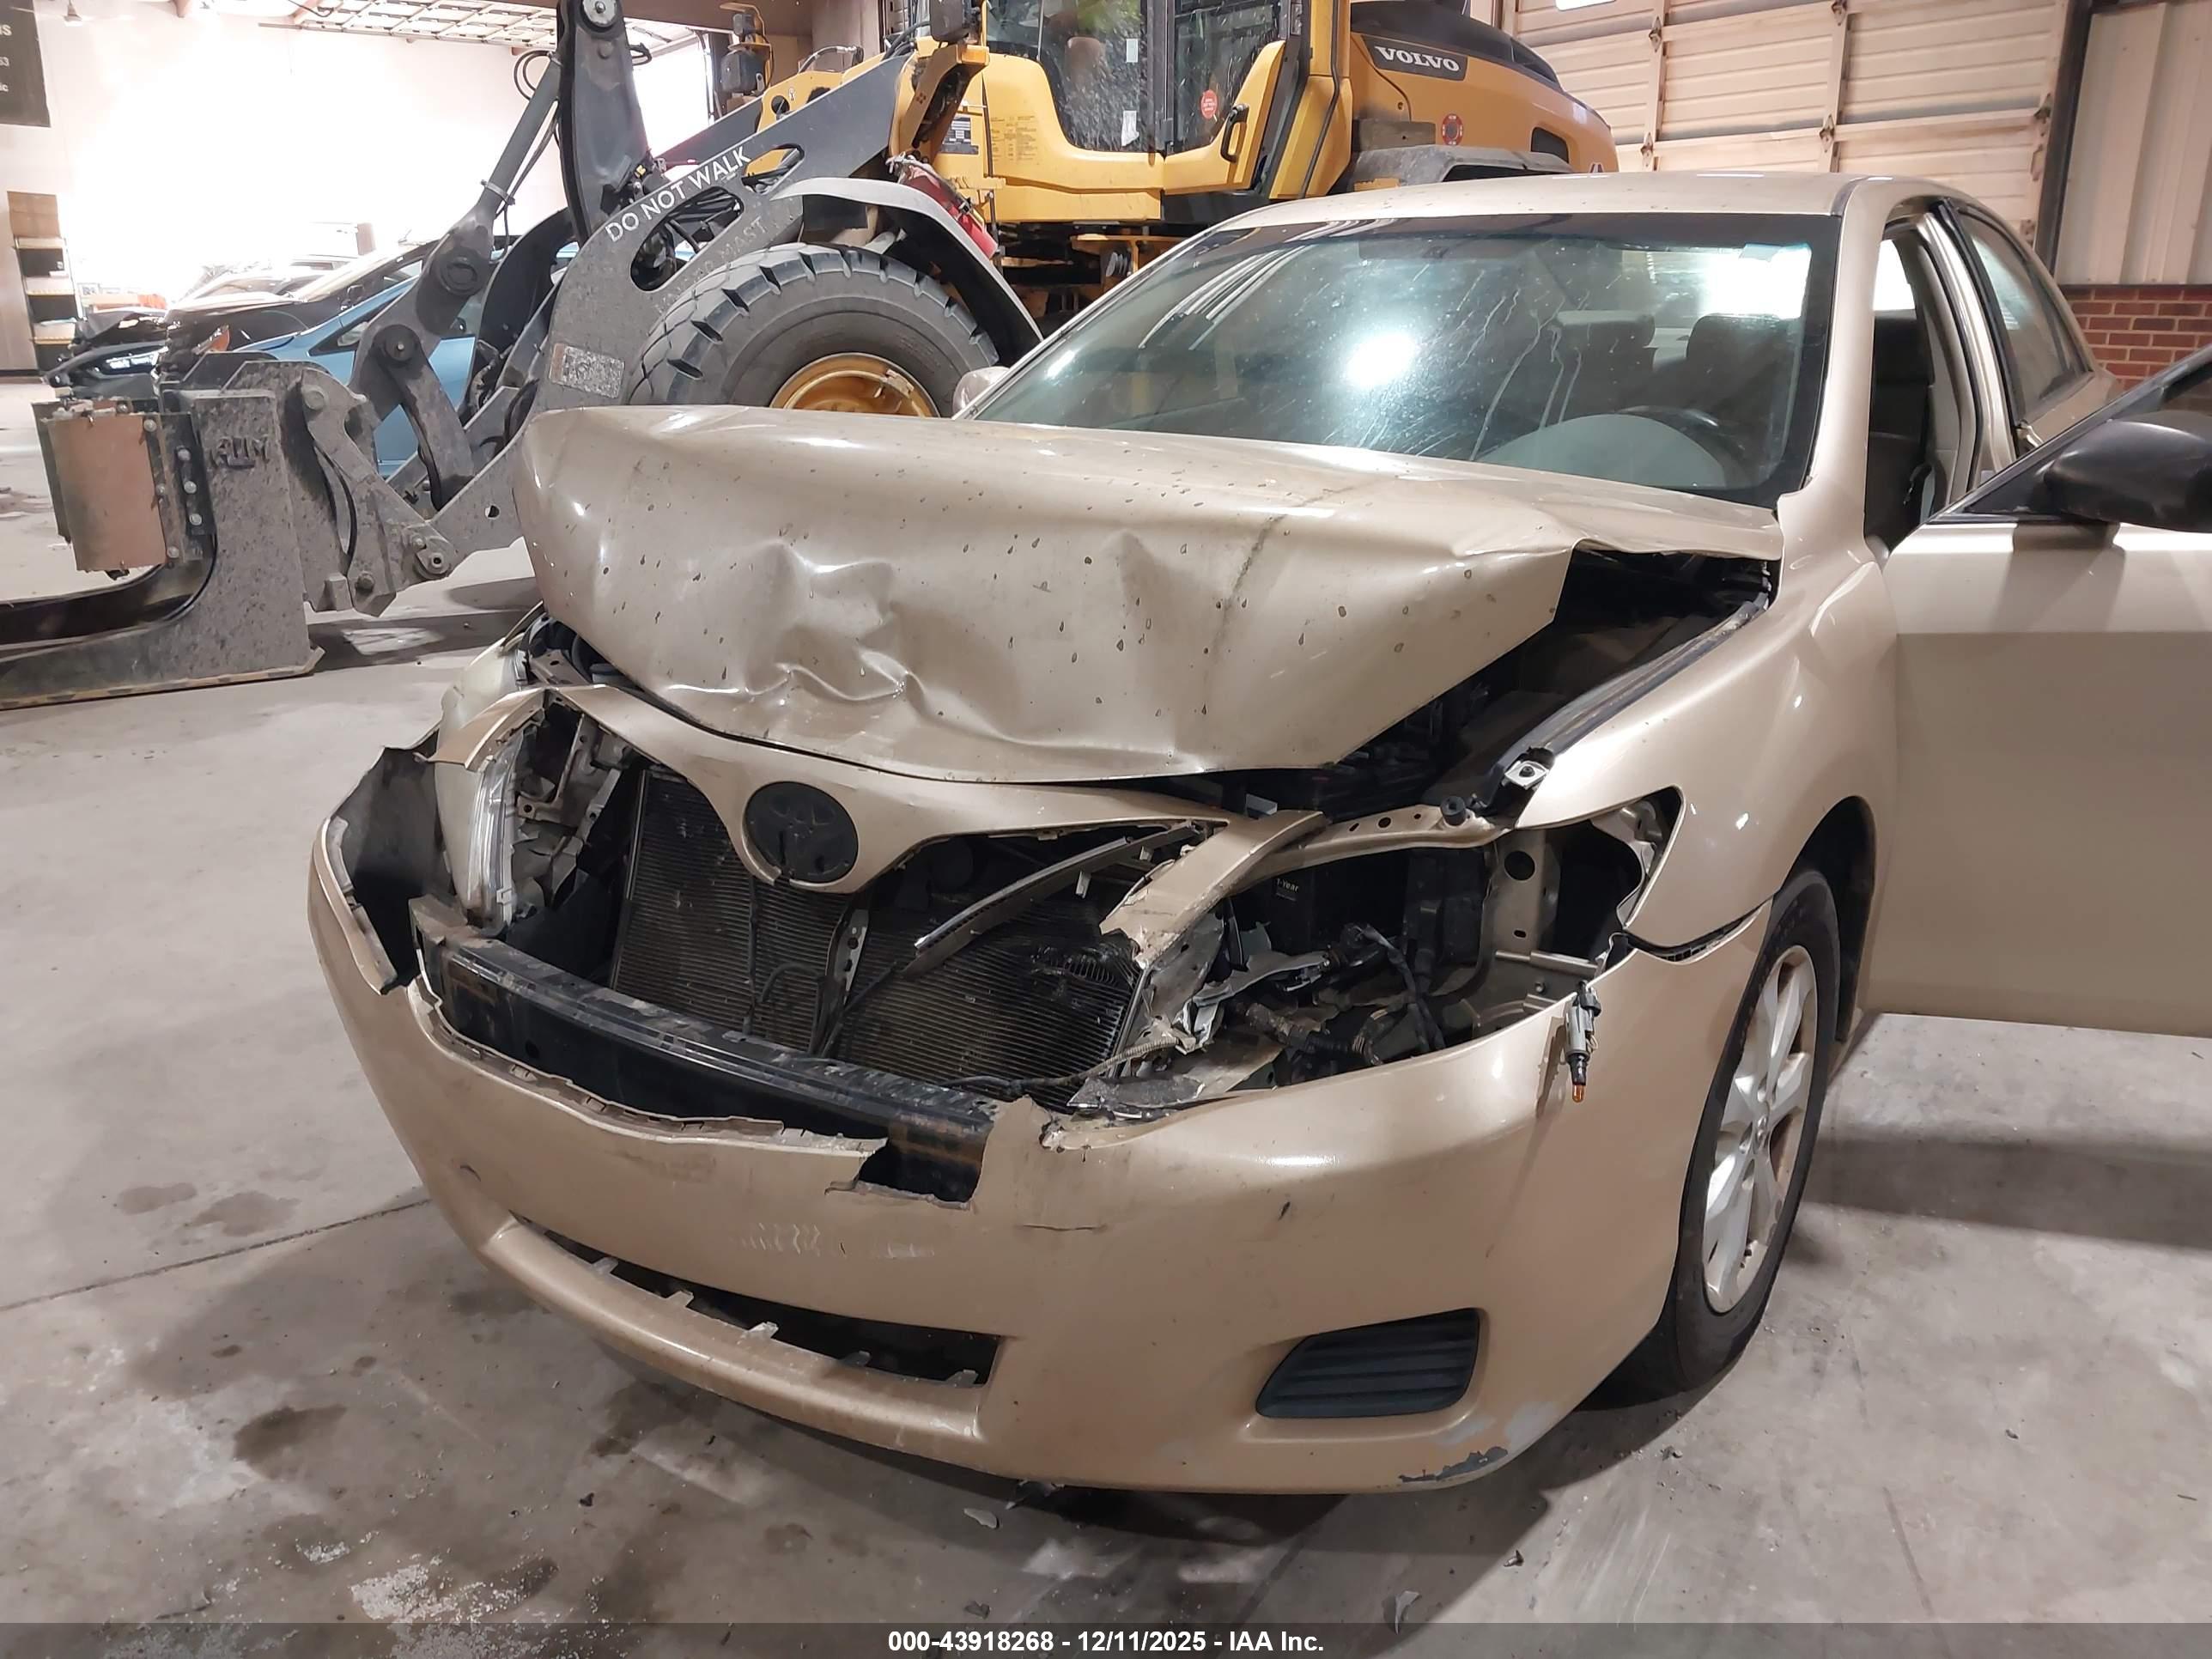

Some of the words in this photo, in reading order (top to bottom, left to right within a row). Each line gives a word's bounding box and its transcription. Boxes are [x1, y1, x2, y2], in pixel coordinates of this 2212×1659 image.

[1374, 46, 1460, 71] VOLVO
[605, 212, 640, 242] DO
[640, 180, 686, 221] NOT
[687, 146, 752, 190] WALK
